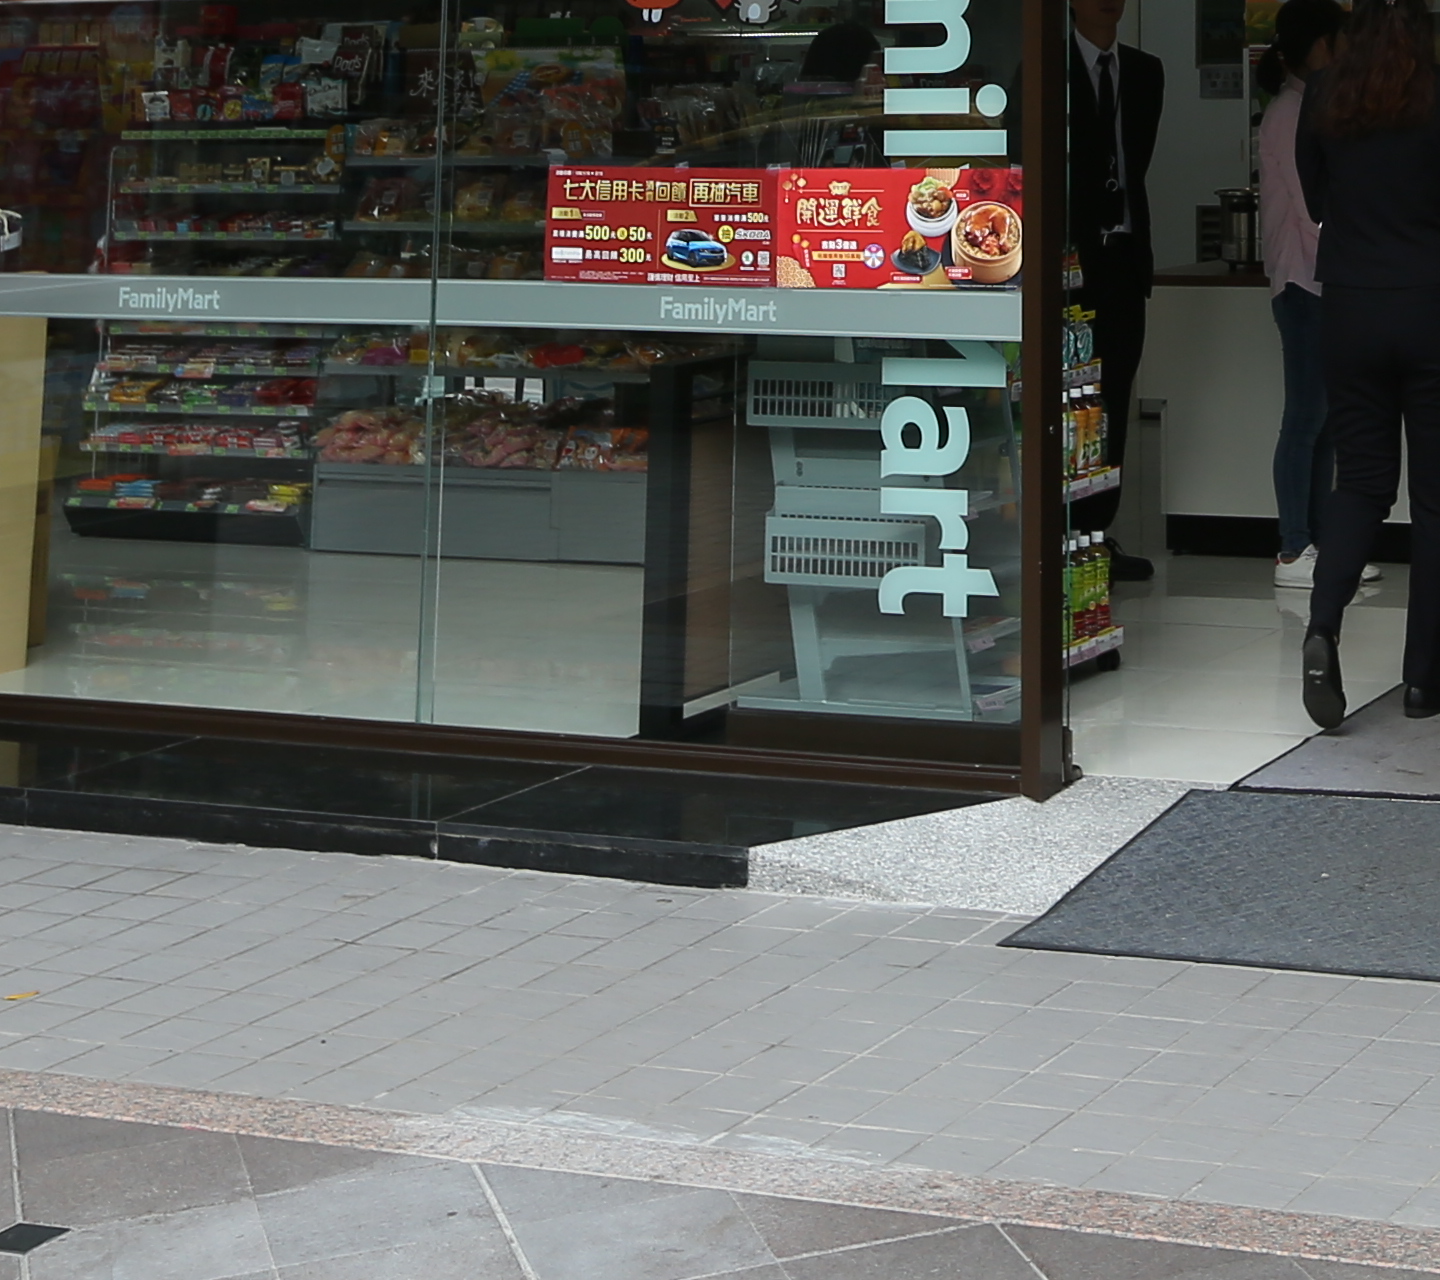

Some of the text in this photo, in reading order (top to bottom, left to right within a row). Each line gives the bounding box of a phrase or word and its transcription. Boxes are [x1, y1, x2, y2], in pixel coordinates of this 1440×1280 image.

[693, 181, 759, 203] 再抽汽車
[796, 197, 883, 227] 開運鮮食
[119, 287, 220, 312] FamilyMart
[660, 297, 777, 324] FamilyMart
